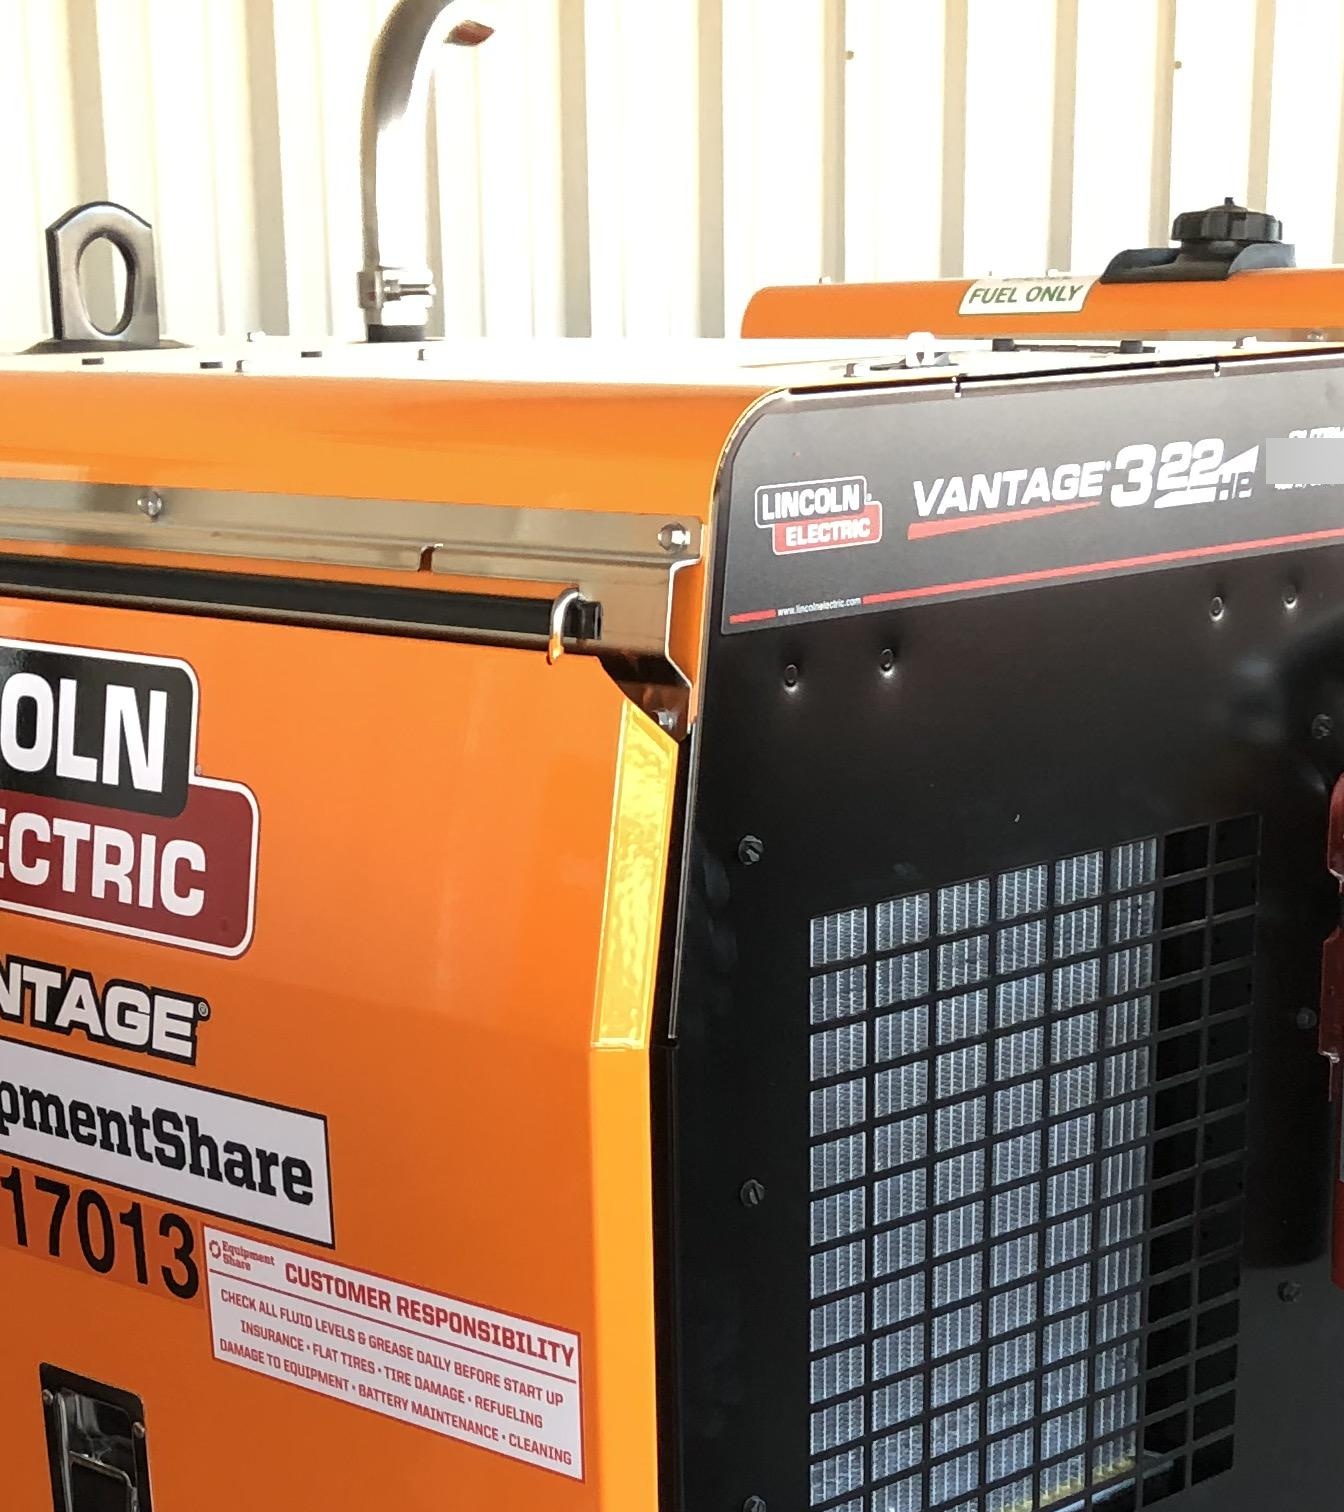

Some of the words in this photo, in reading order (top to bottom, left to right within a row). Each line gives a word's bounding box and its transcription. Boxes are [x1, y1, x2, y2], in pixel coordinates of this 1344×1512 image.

[969, 287, 1018, 304] FUEL
[1026, 285, 1084, 302] ONLY
[1110, 438, 1224, 508] 322
[762, 484, 860, 520] LINCOLN
[786, 517, 871, 546] ELECTRIC
[777, 597, 862, 617] www.lincolnelectric.com
[222, 1240, 275, 1266] Equipment
[223, 1254, 251, 1271] Share
[285, 1263, 392, 1313] CUSTOMER
[397, 1295, 574, 1367] RESPONSIBILITY
[221, 1289, 257, 1312] CHECK
[259, 1301, 278, 1318] ALL
[280, 1307, 313, 1329] FLUID
[316, 1318, 355, 1342] LEVELS
[358, 1331, 366, 1345] &
[369, 1335, 413, 1361] GREASE
[417, 1350, 451, 1372] DAILY
[454, 1361, 500, 1388] BEFORE
[504, 1378, 543, 1402] START
[546, 1390, 564, 1407] UP
[241, 1320, 304, 1351] INSURANCE
[313, 1343, 338, 1364] FLAT
[340, 1352, 375, 1375] TIRES
[384, 1366, 411, 1386] TIRE
[415, 1376, 465, 1404] DAMAGE
[475, 1395, 543, 1429] REFUELING
[220, 1338, 265, 1364] DAMAGE
[266, 1353, 281, 1369] TO
[284, 1359, 349, 1391] EQUIPMENT
[359, 1384, 408, 1411] BATTERY
[411, 1401, 499, 1441] MAINTENANCE
[509, 1433, 572, 1465] CLEANING
